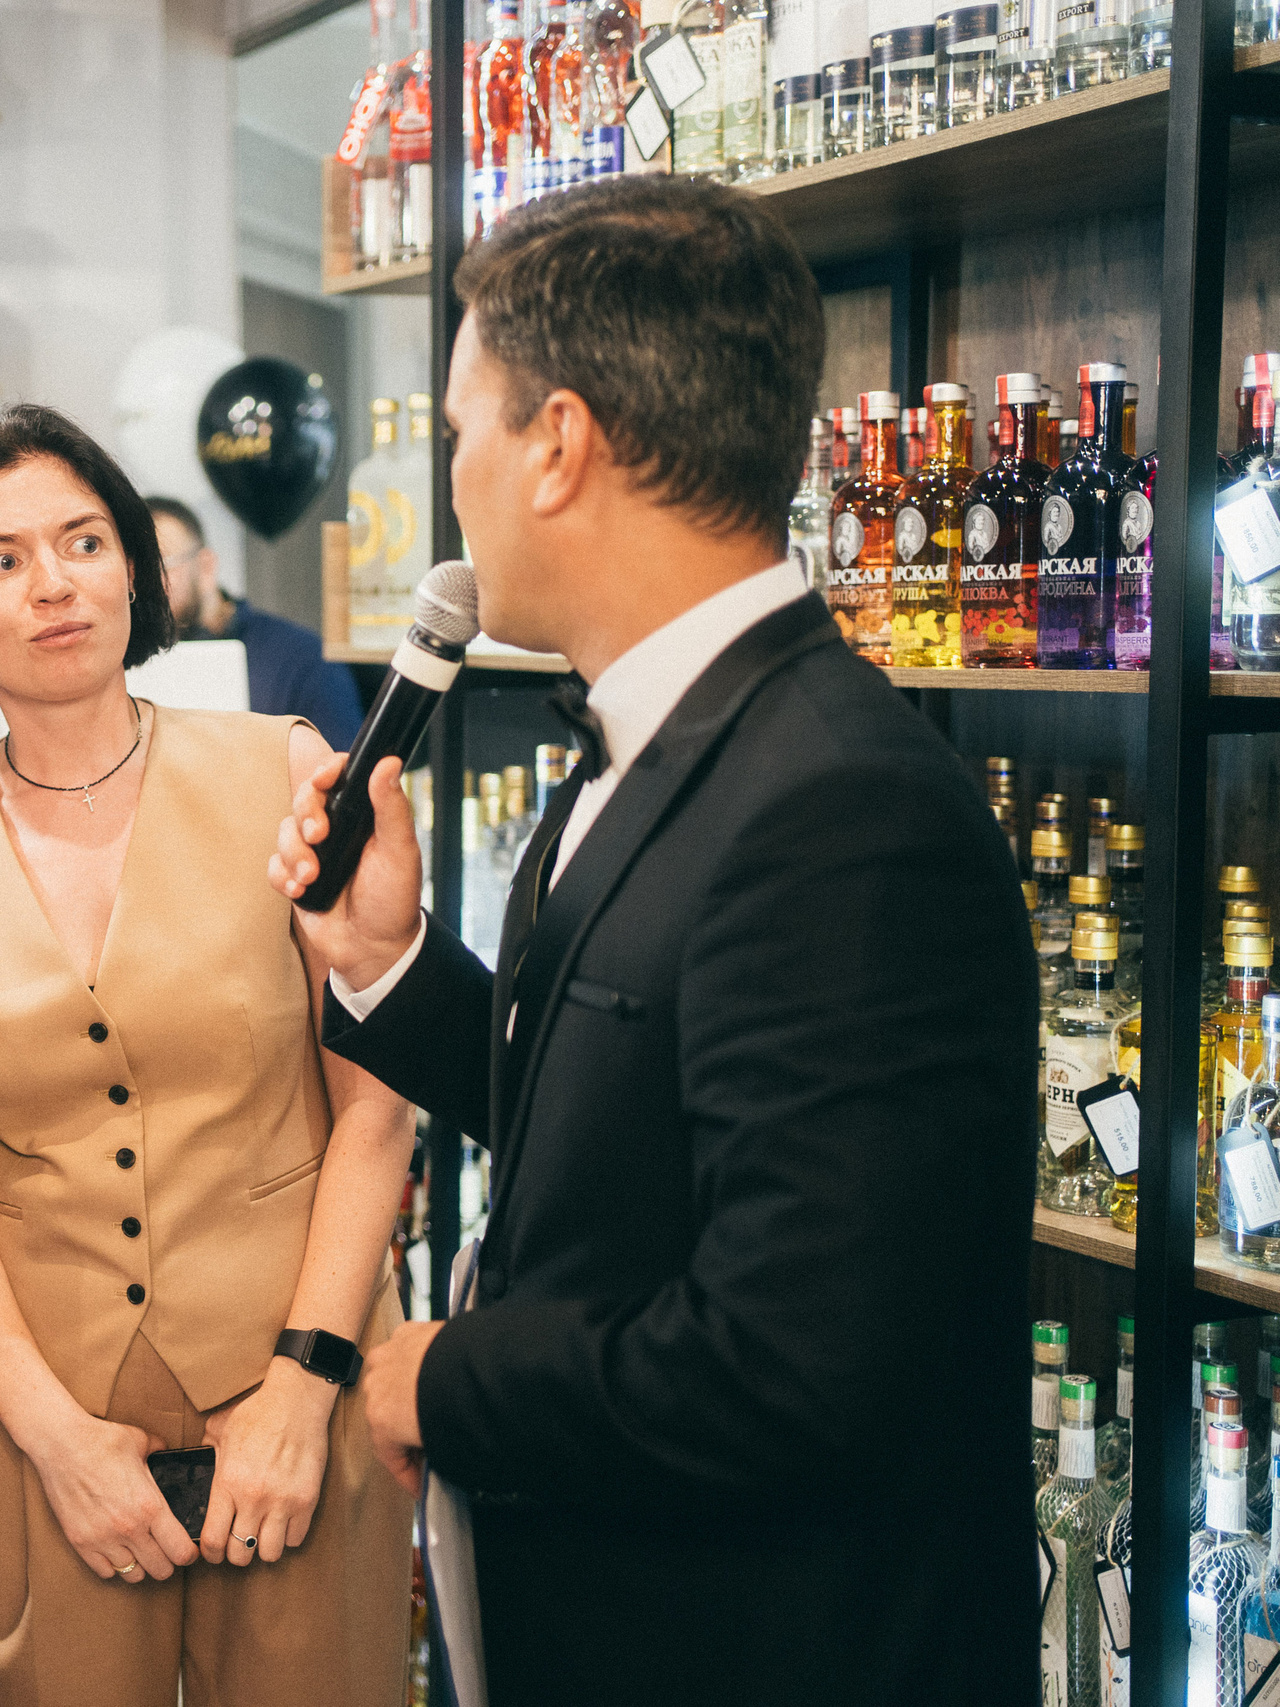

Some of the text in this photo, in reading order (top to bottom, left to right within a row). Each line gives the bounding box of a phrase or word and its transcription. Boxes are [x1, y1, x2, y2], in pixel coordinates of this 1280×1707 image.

[1058, 4, 1090, 20] EXPORT
[998, 29, 1025, 43] EXPORT
[892, 564, 949, 582] АРСКАЯ
[961, 563, 1022, 582] АРСКАЯ
[1038, 557, 1098, 575] АРСКАЯ
[828, 567, 887, 585] АРСКАЯ
[1189, 1618, 1213, 1636] anic
